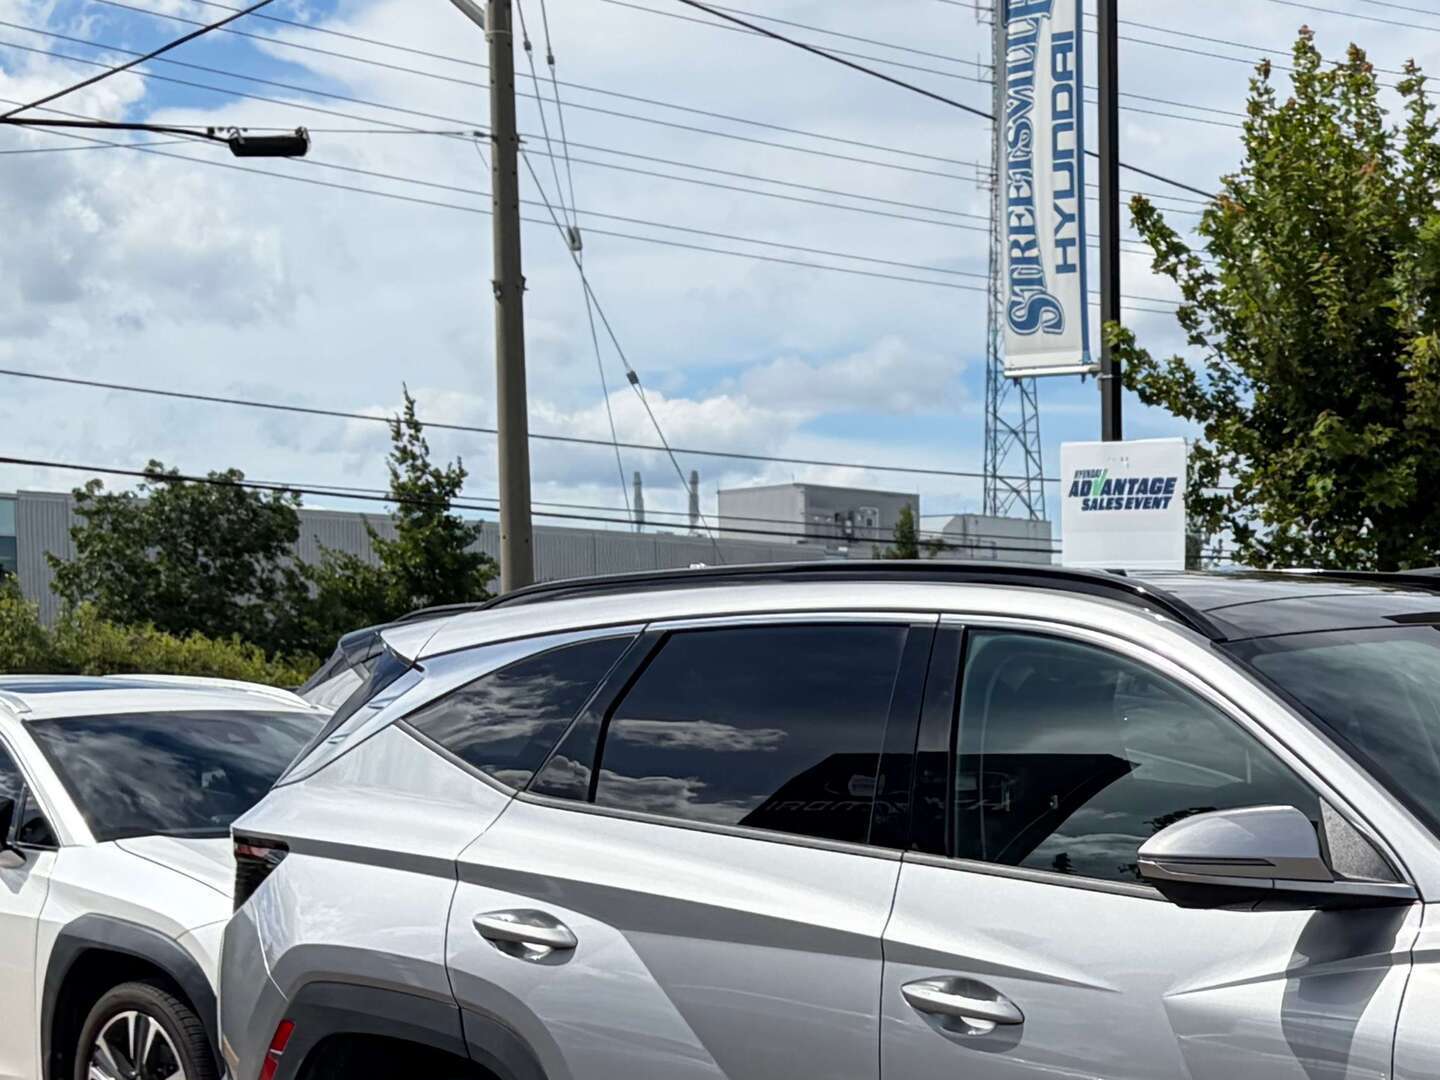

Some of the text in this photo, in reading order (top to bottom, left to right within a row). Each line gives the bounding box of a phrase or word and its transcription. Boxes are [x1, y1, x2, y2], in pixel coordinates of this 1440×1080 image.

[1005, 0, 1064, 335] STREETSVILL
[1050, 31, 1077, 274] HYUNDAI
[1068, 470, 1178, 498] ADVANTAGE
[1081, 496, 1173, 511] SALES EVENT
